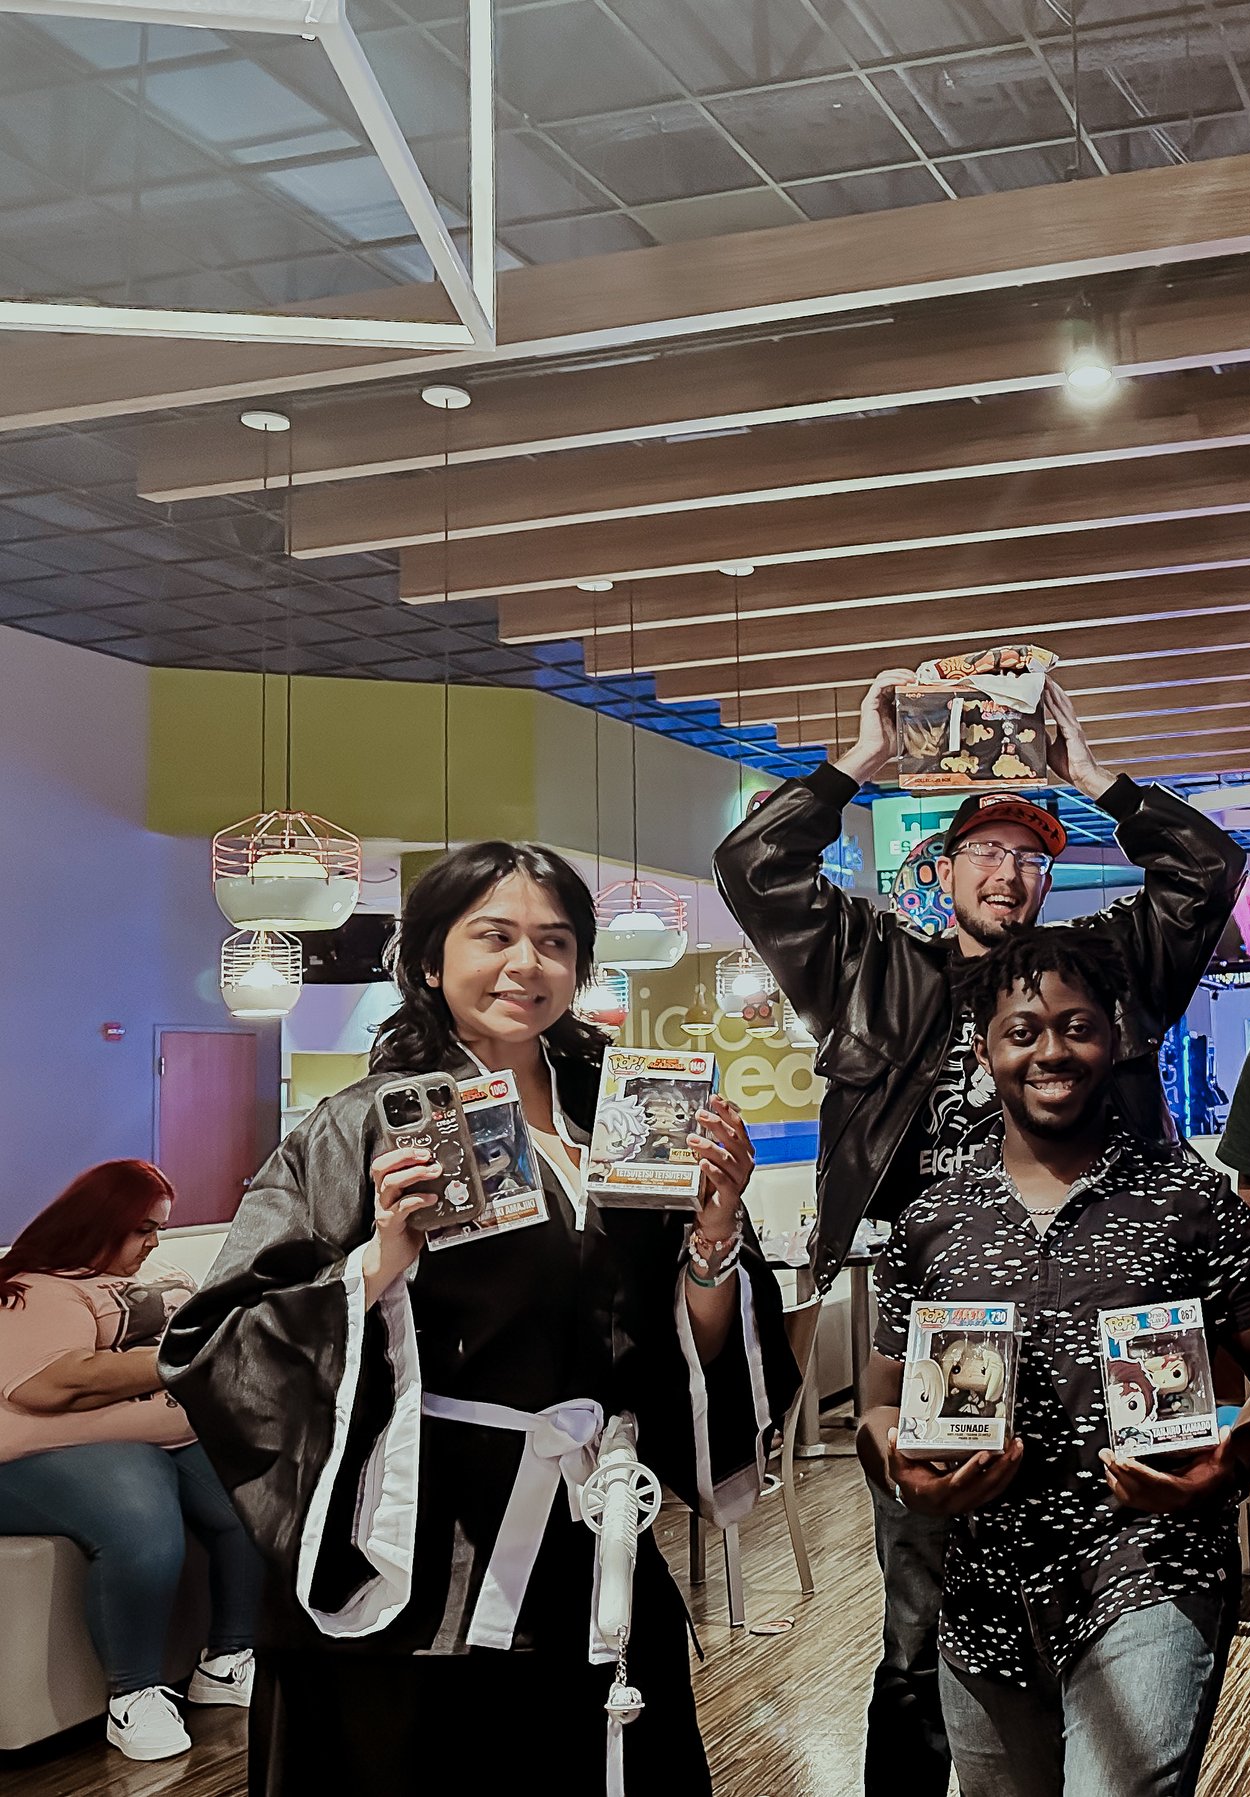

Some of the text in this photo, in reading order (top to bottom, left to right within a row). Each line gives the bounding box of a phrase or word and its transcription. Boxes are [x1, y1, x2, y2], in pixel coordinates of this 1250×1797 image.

[608, 1053, 647, 1071] POP!
[915, 1307, 949, 1325] POP!
[990, 1310, 1007, 1323] 730
[1104, 1315, 1138, 1334] POP!
[1180, 1309, 1194, 1321] 867
[950, 1423, 990, 1433] TSUNADE
